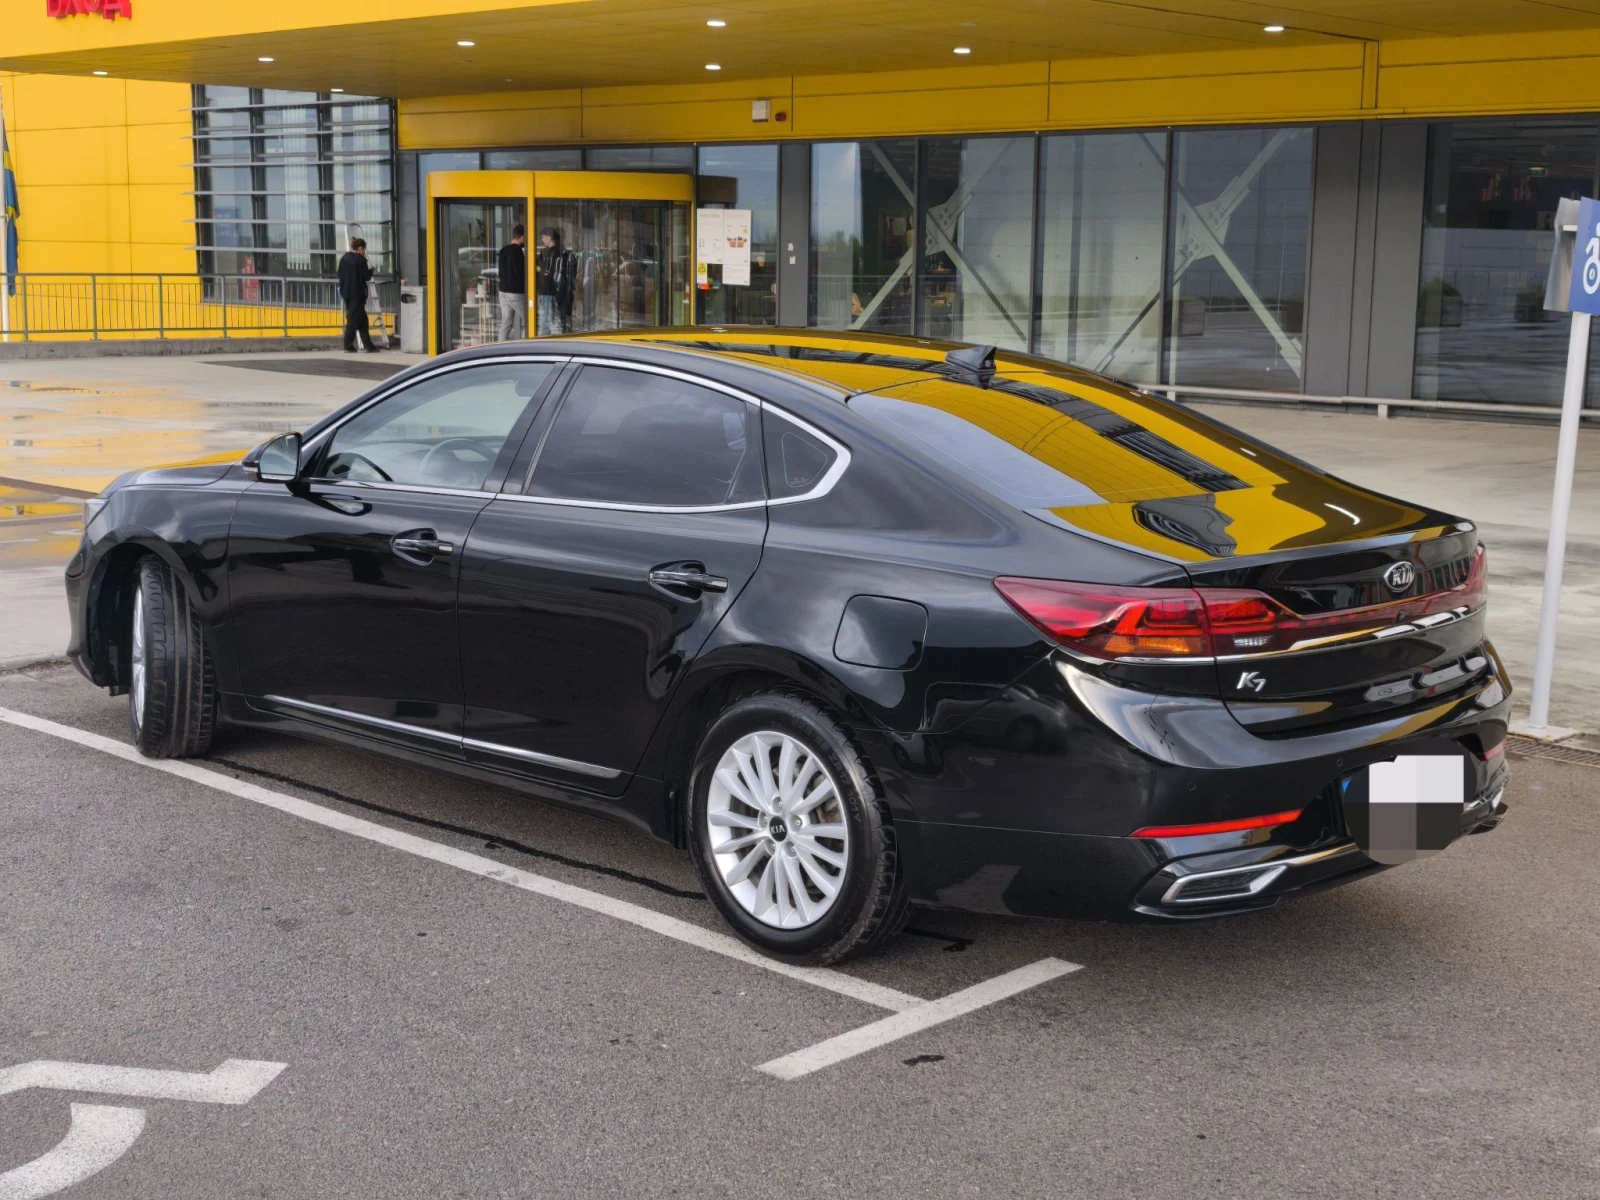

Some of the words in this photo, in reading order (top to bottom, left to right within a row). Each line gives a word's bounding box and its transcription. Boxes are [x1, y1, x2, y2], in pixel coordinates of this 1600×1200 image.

[1392, 566, 1414, 586] KIA
[1236, 671, 1266, 692] K7
[828, 752, 851, 785] ZR17
[846, 790, 862, 823] 101Y
[770, 824, 786, 834] KIA
